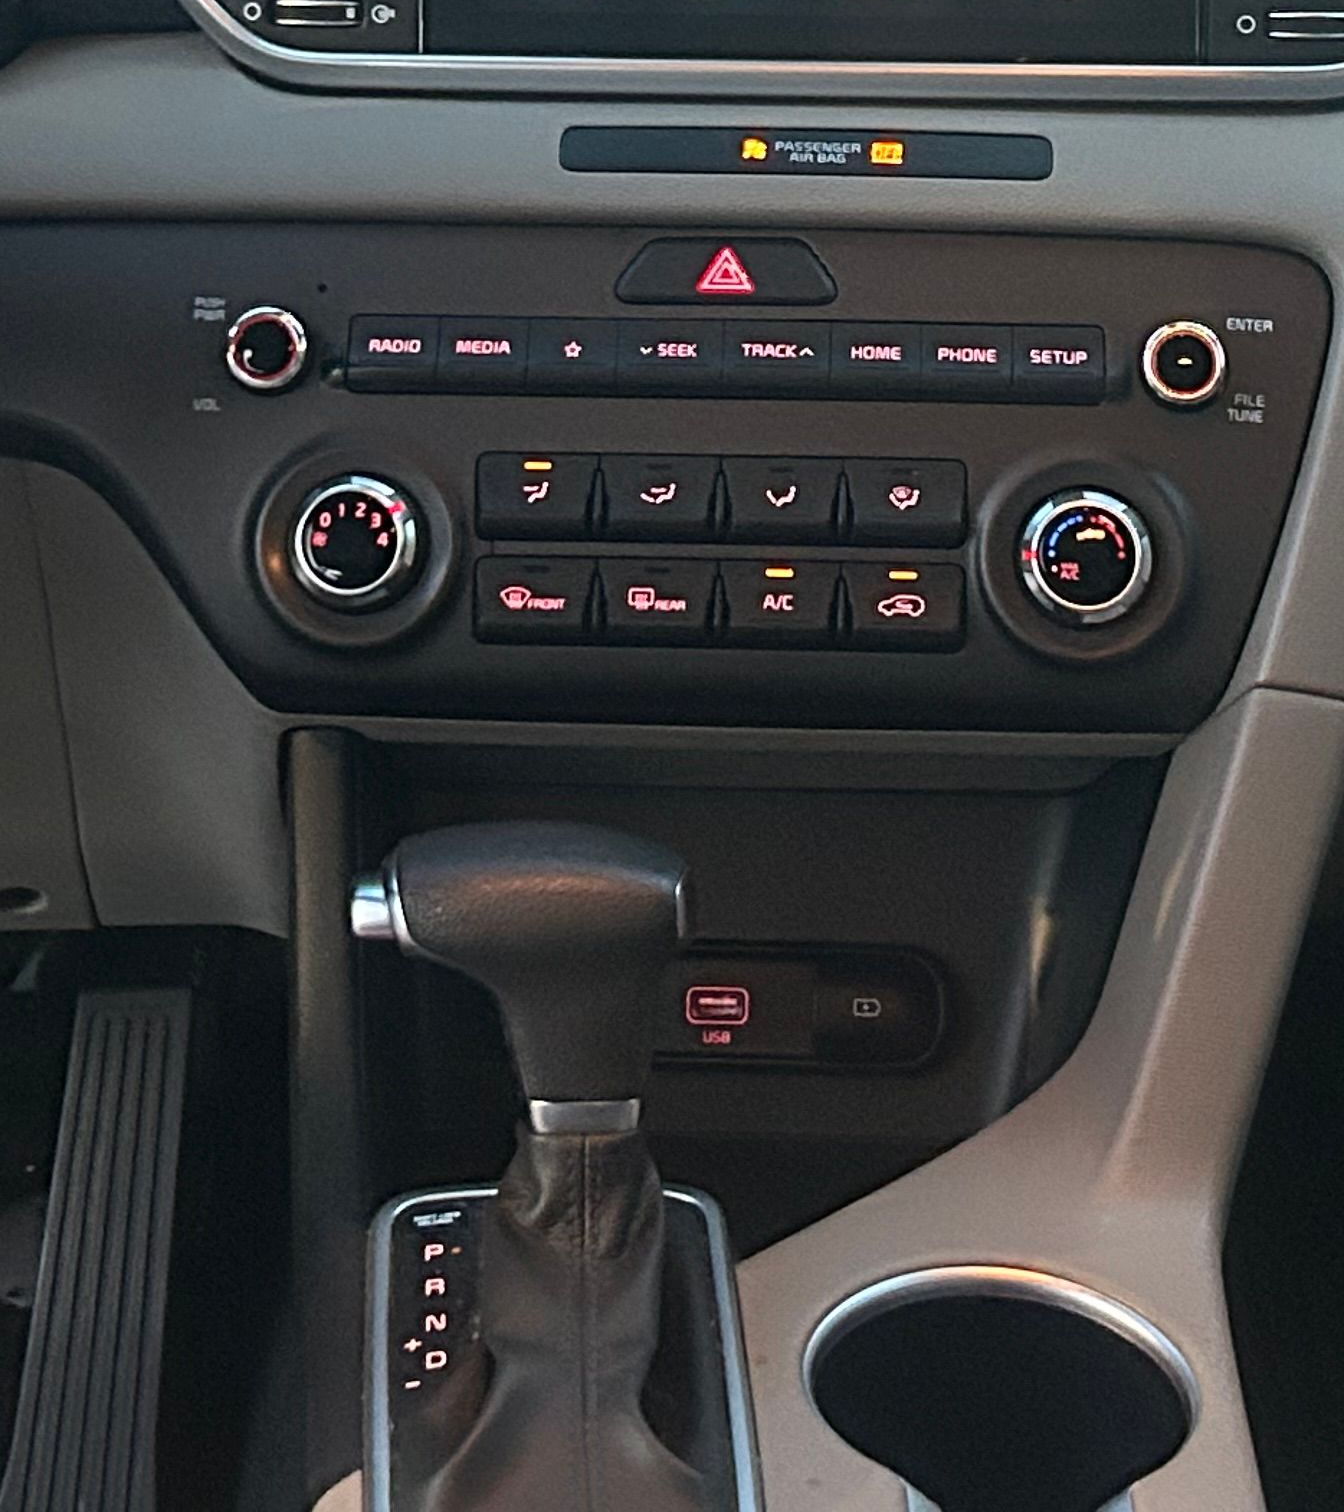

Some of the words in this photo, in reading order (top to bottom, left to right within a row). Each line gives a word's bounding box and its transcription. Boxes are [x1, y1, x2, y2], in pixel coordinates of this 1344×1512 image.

[775, 140, 862, 155] PASSENGER
[789, 151, 814, 164] AIR
[817, 153, 847, 165] BAG
[1226, 317, 1274, 333] ENTER
[368, 338, 422, 355] RADIO
[456, 338, 511, 356] MEDIA
[657, 343, 698, 359] SEEK
[741, 343, 798, 359] TRACK
[850, 345, 902, 361] HOME
[937, 346, 998, 364] PHONE
[1029, 348, 1088, 366] SETUP
[1233, 393, 1266, 408] FILE
[1227, 408, 1264, 424] TUNE
[319, 511, 332, 528] 0
[338, 502, 346, 518] 1
[354, 501, 367, 518] 2
[369, 511, 382, 529] 3
[376, 531, 389, 548] 4
[527, 597, 566, 610] FRONT
[654, 598, 686, 611] REAR
[762, 594, 794, 612] A/C
[702, 1030, 732, 1045] USB
[423, 1242, 445, 1262] P
[424, 1313, 447, 1332] N
[424, 1349, 448, 1371] D
